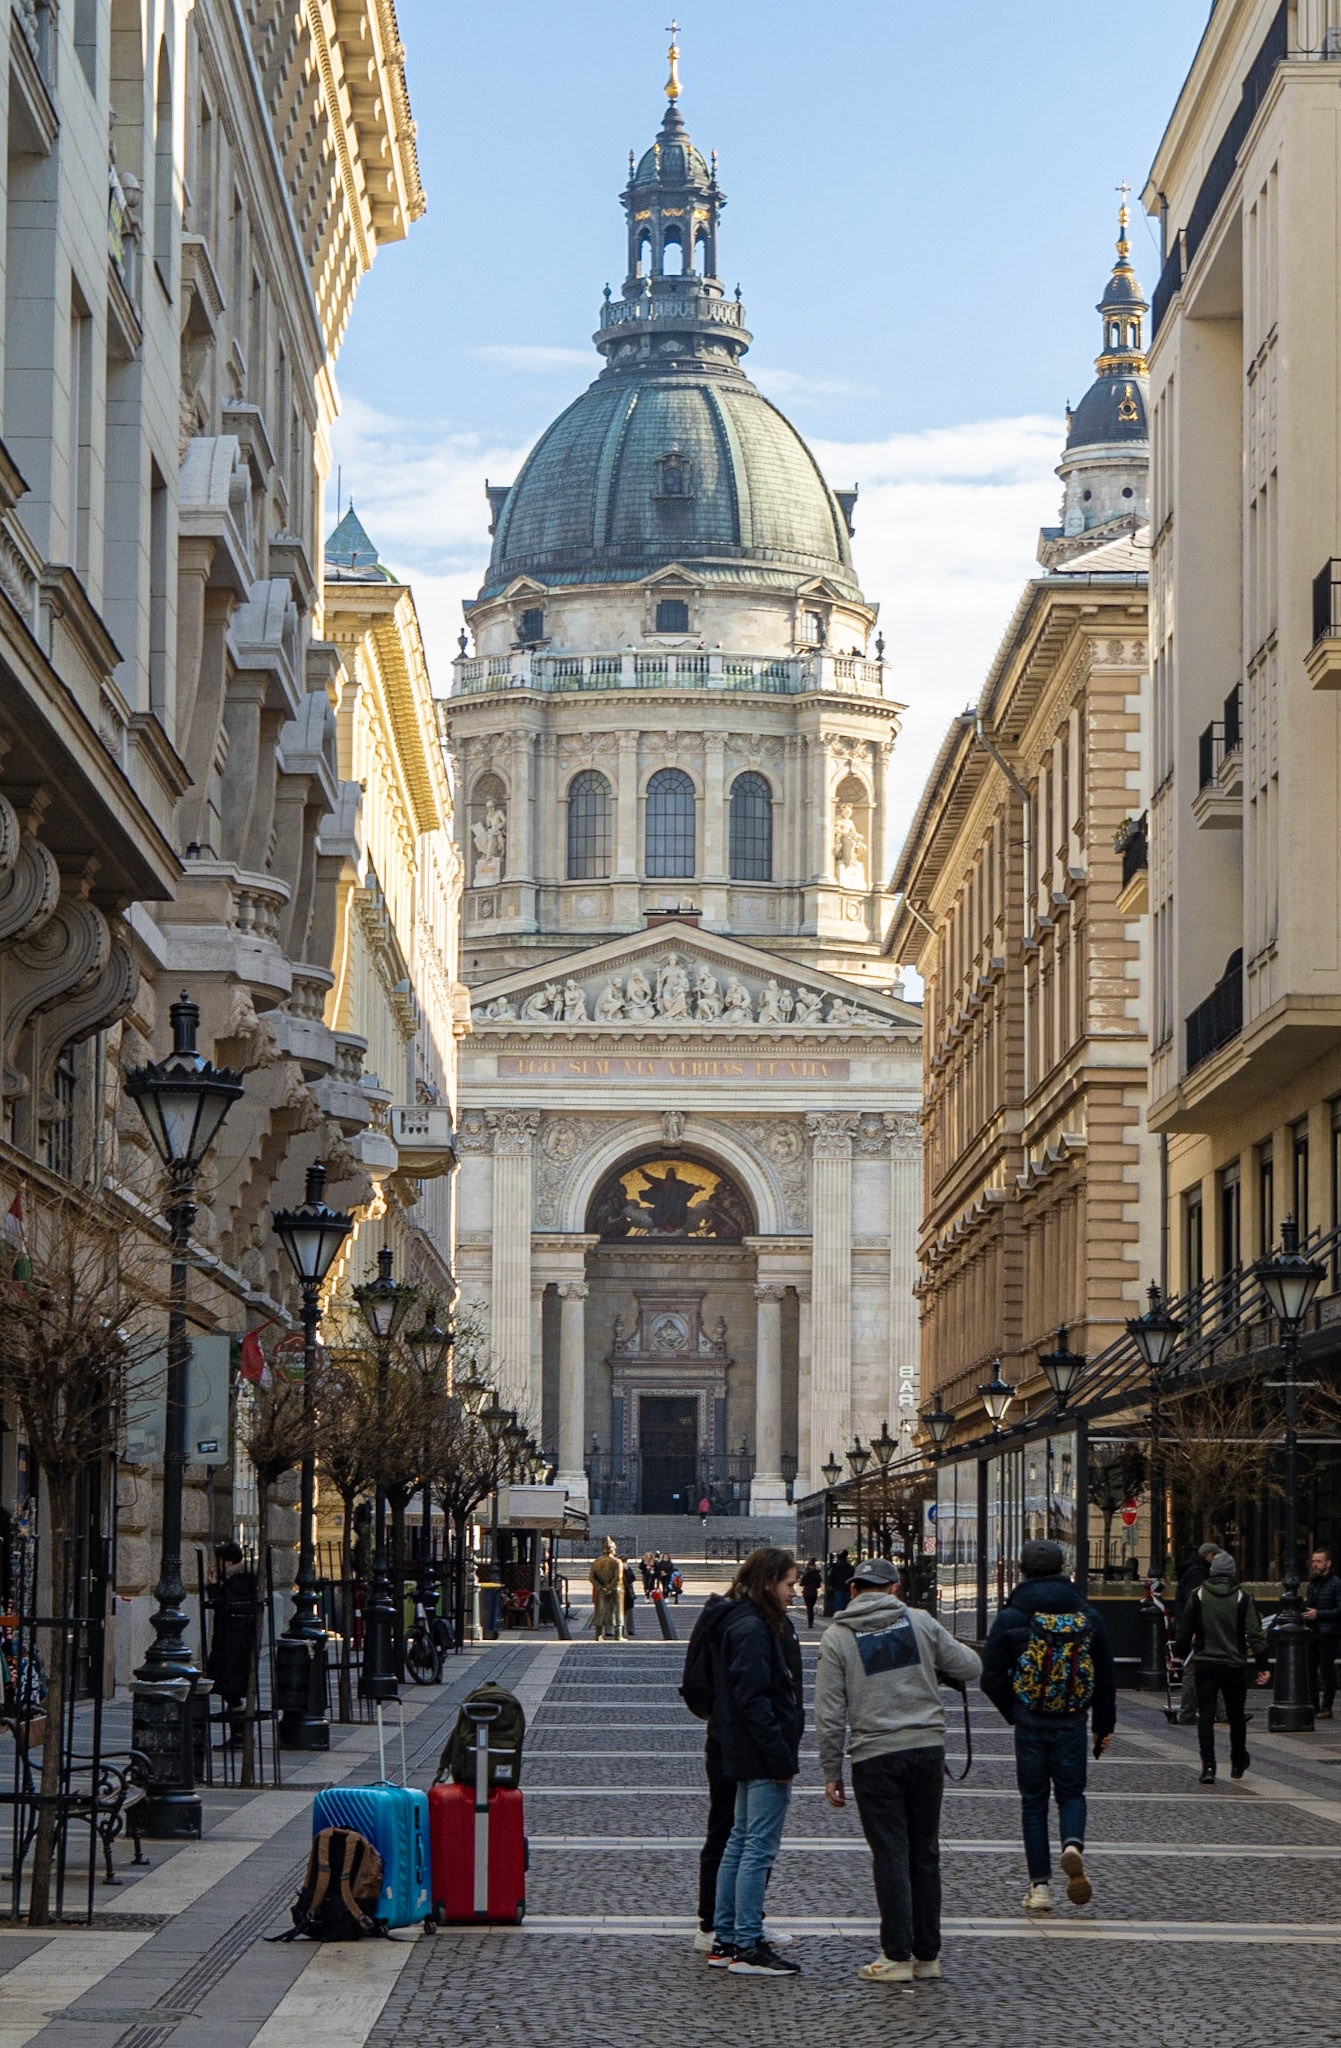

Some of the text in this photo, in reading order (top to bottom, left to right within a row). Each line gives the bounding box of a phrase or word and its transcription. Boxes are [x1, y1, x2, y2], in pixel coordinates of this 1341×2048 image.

[517, 1059, 829, 1077] EGO SUM VIA VERITAS ET VITA
